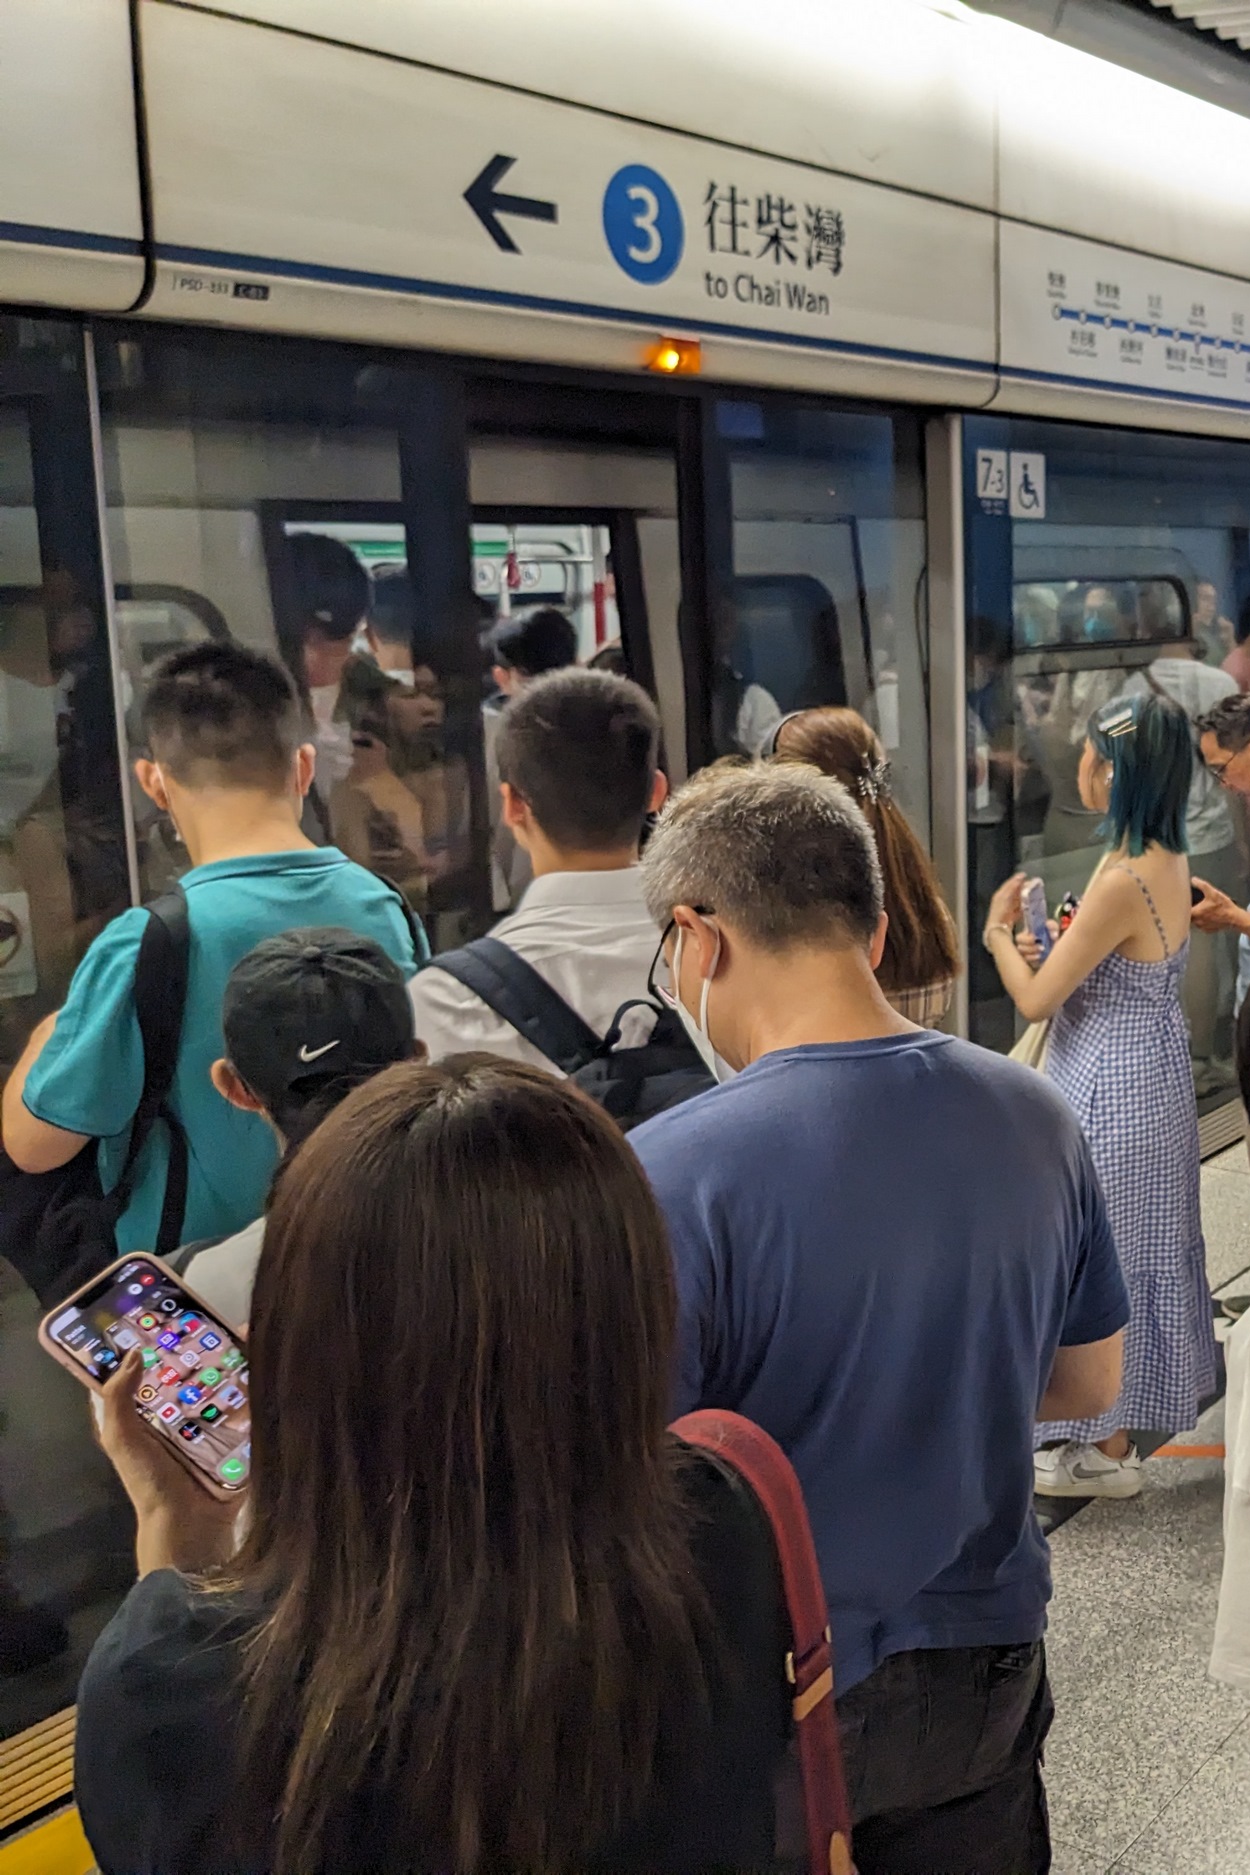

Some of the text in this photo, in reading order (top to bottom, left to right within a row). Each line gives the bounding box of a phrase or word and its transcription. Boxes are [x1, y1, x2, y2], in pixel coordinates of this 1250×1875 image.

[626, 186, 663, 264] 3
[704, 181, 844, 276] 往柴灣
[705, 271, 830, 316] to Chai Wan
